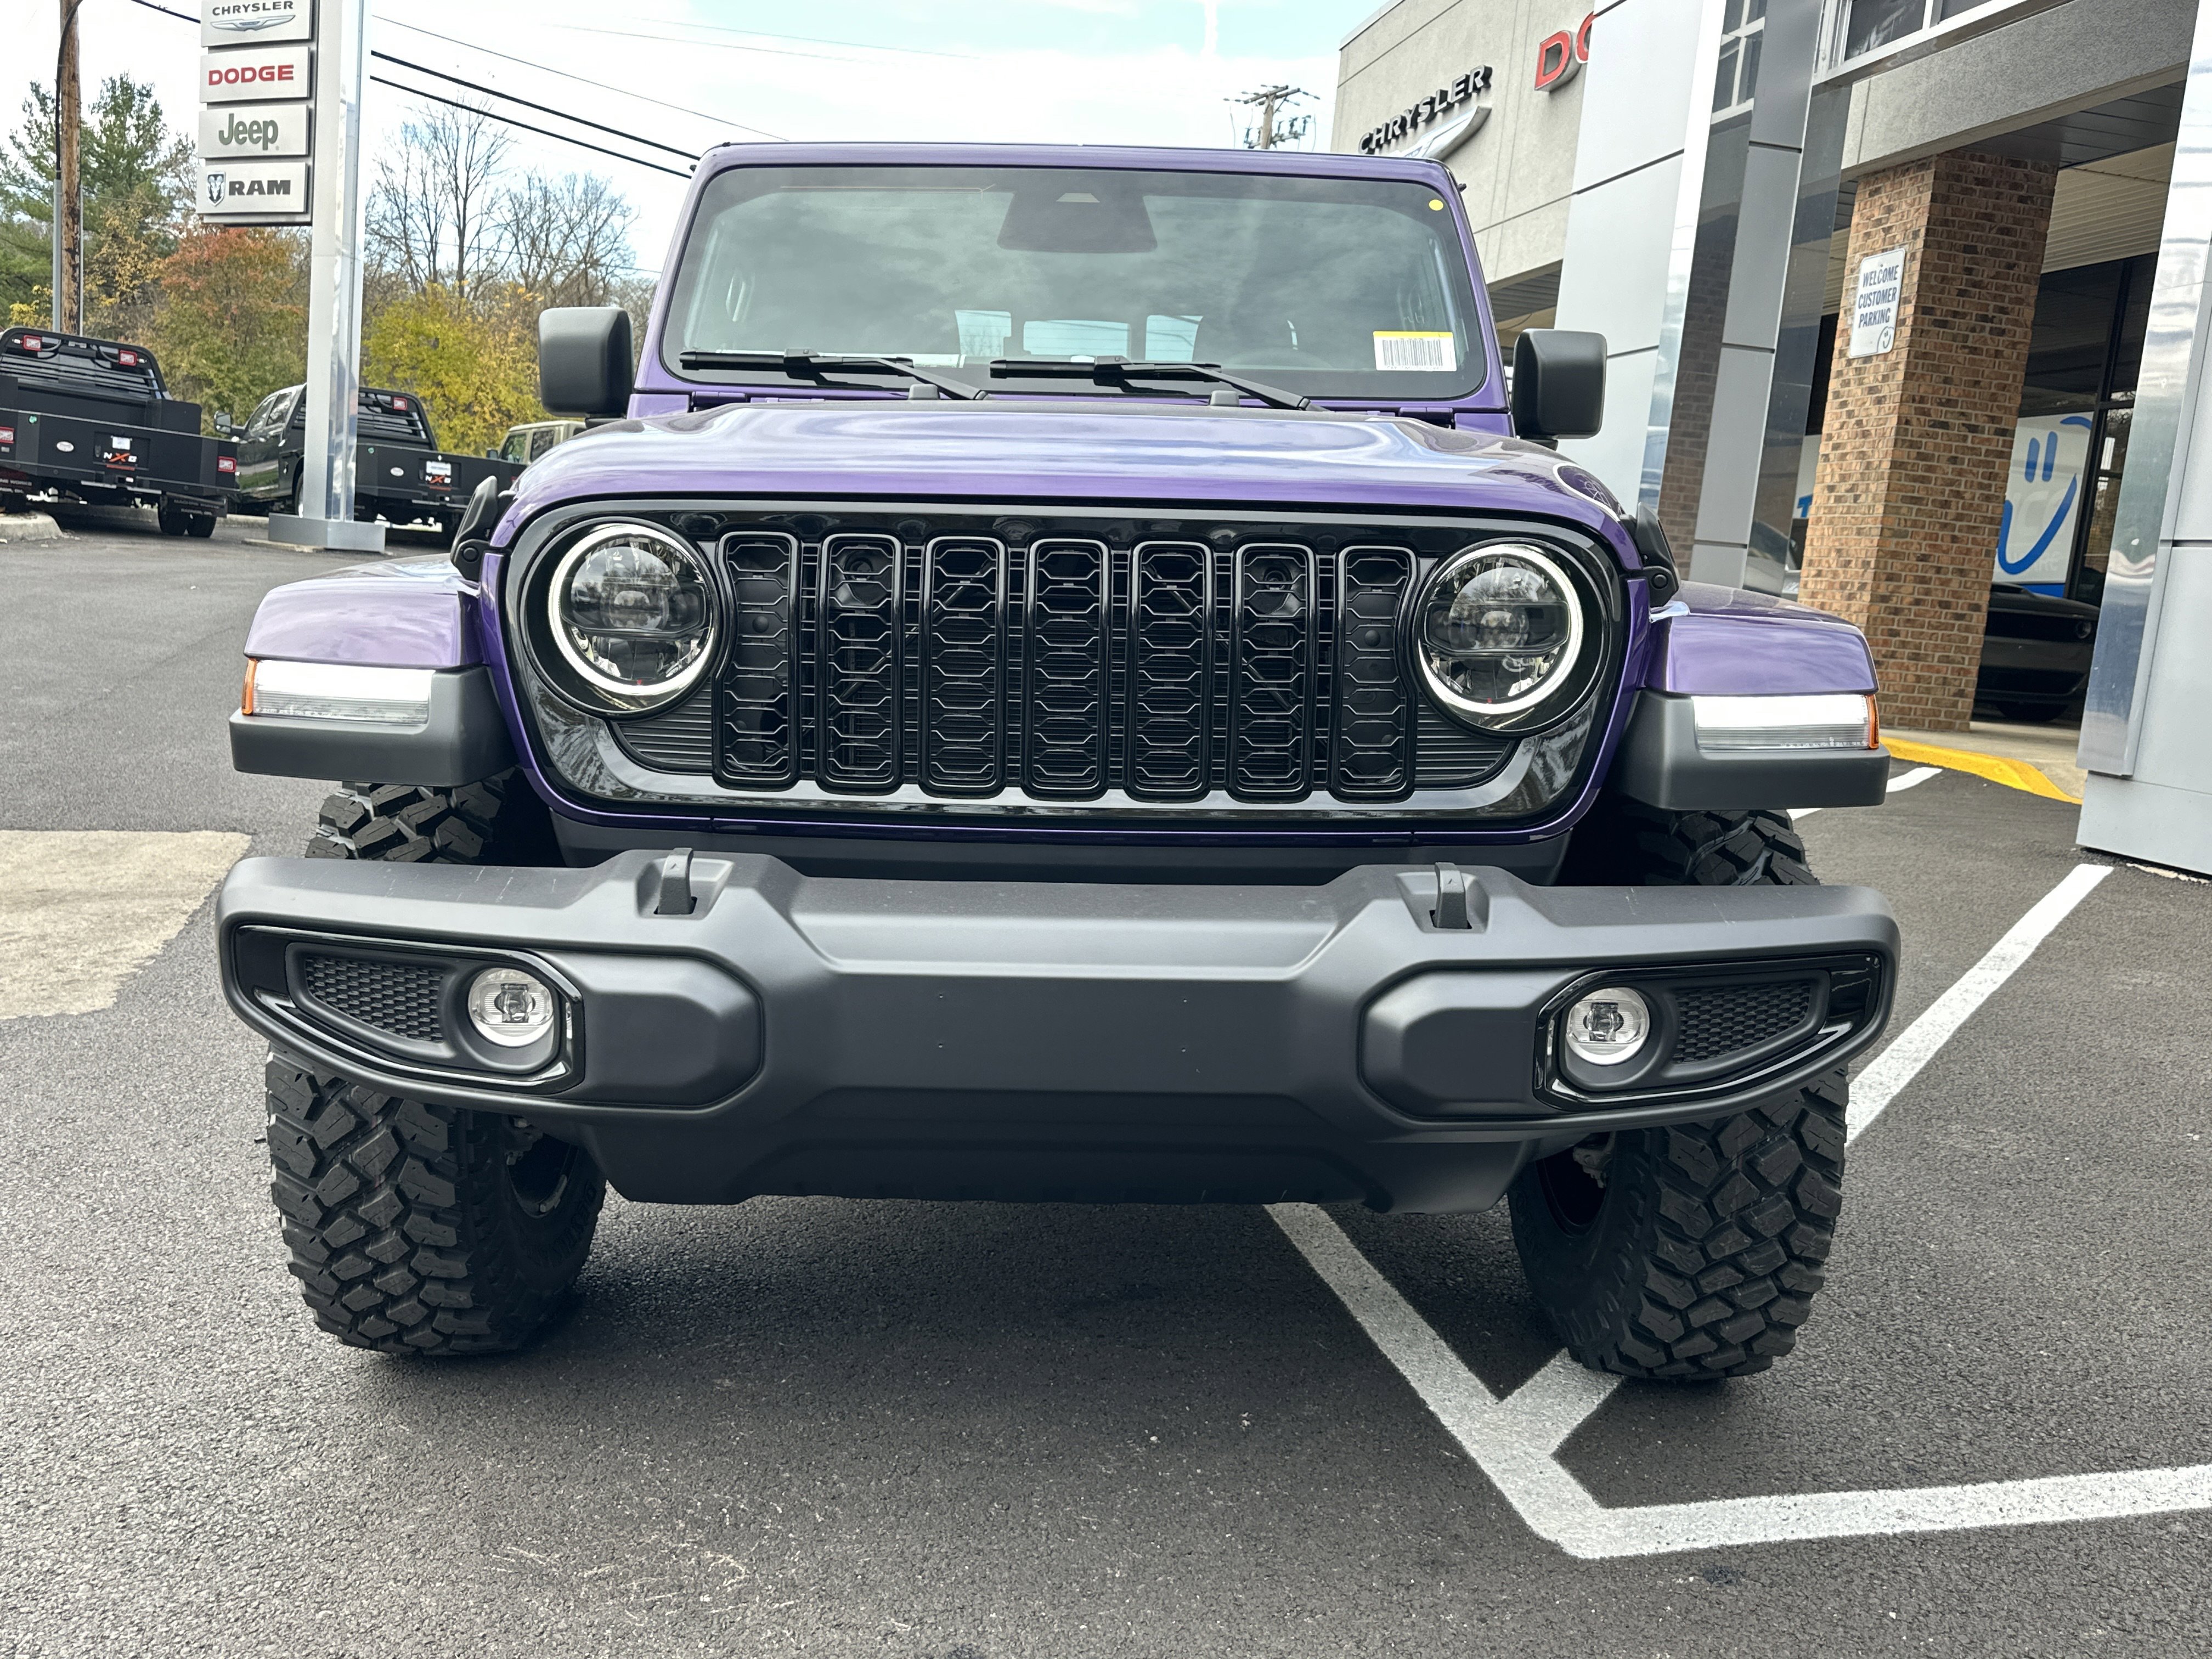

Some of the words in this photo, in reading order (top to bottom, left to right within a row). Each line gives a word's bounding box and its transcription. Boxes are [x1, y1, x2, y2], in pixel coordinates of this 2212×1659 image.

[212, 1, 294, 16] CHRYSLER
[208, 65, 294, 86] DODGE
[1358, 64, 1492, 155] CHRYSLER
[218, 113, 278, 150] Jeep
[229, 180, 291, 196] RAM
[1863, 264, 1899, 287] WELCOME
[1858, 287, 1897, 309] CUSTOMER
[1858, 308, 1891, 329] PARKING
